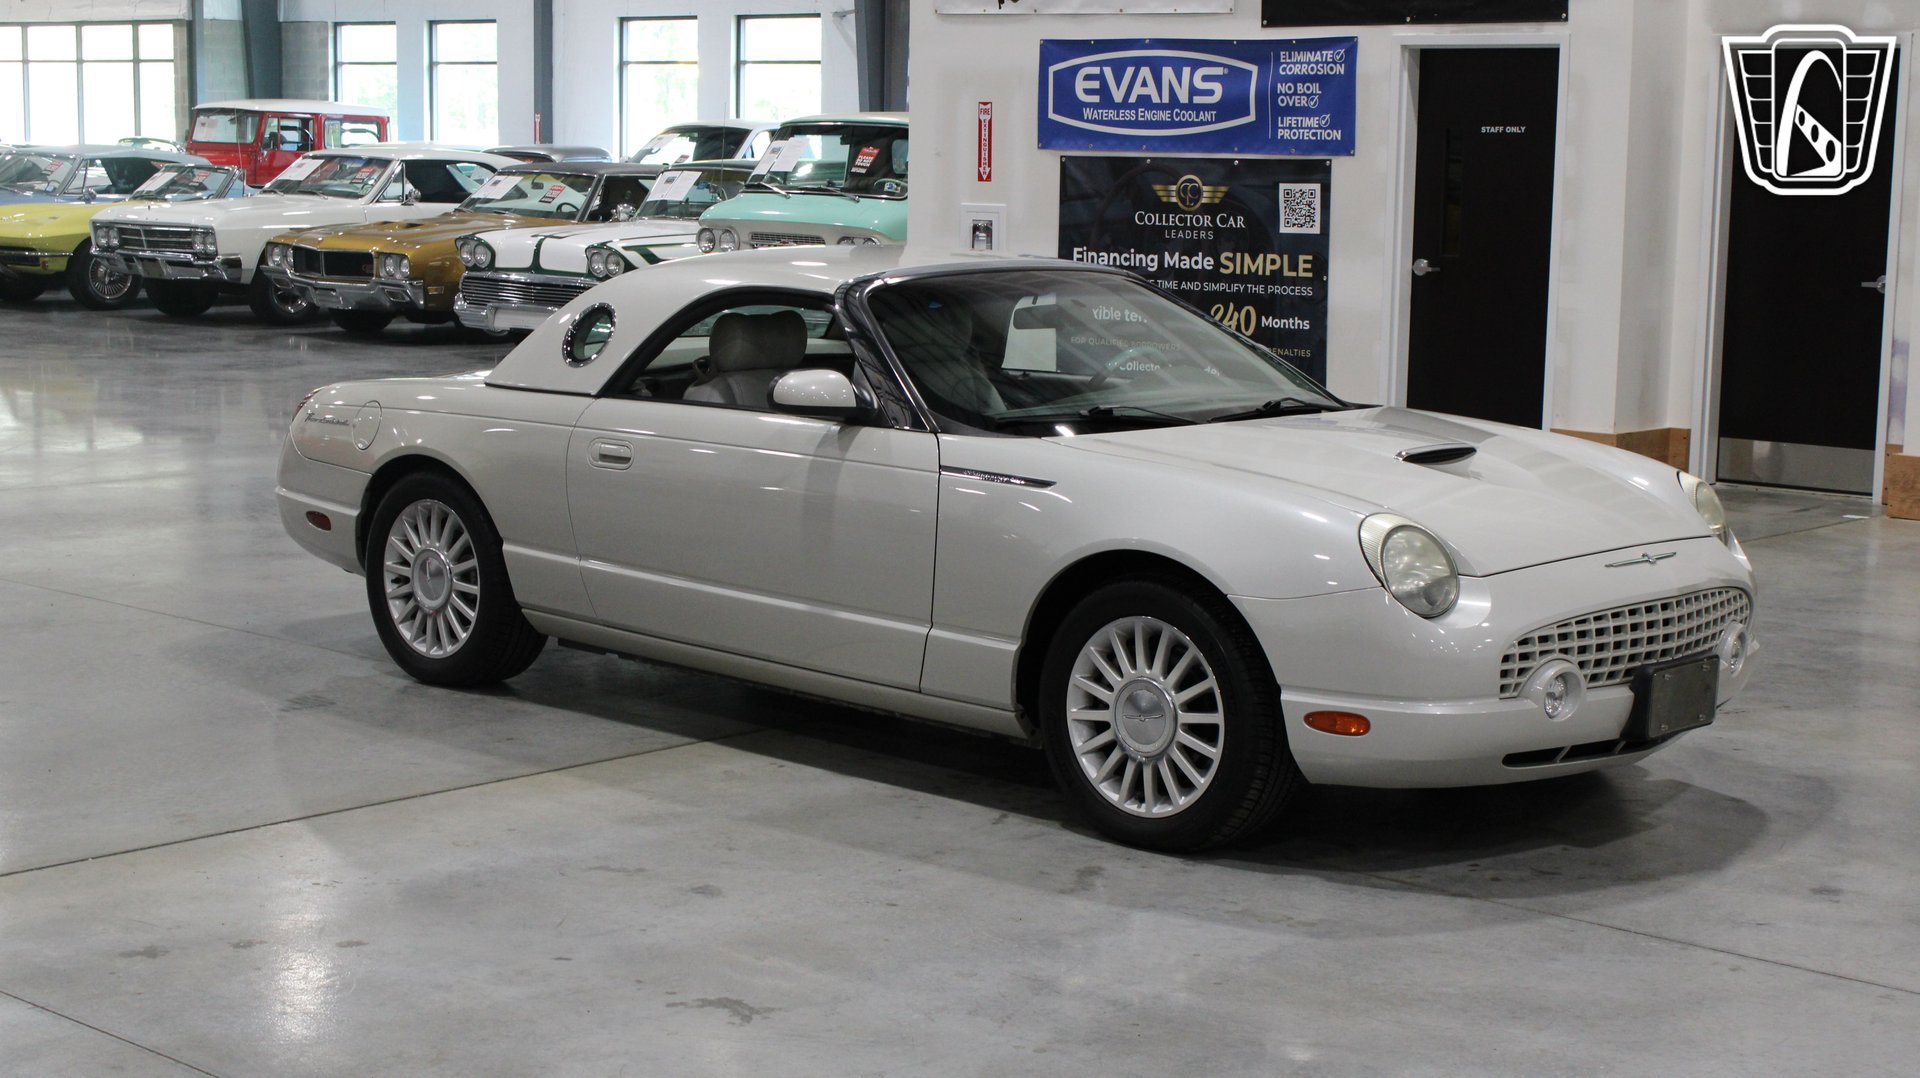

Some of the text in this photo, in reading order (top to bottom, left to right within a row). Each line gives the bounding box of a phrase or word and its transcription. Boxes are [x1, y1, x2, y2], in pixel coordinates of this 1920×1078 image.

[1280, 50, 1334, 62] ELIMINATE
[1279, 63, 1345, 75] CORROSION
[1075, 66, 1224, 104] EVANS
[1277, 82, 1322, 94] NO BOIL
[1277, 95, 1308, 107] OVER
[980, 108, 990, 116] FIRE
[1083, 107, 1217, 122] WATERLESS ENGINE COOLANT
[1277, 116, 1319, 128] LIFETIME
[1277, 129, 1342, 141] PROTECTION
[1134, 211, 1246, 228] COLLECTOR CAR
[1165, 229, 1214, 240] LEADERS
[1073, 246, 1313, 278] Financing Made SIMPLE
[1156, 279, 1179, 290] TIME
[1180, 281, 1202, 291] AND
[1203, 281, 1246, 293] SIMPLIFY
[1247, 284, 1265, 294] THE
[1267, 285, 1313, 296] PROCESS
[1210, 301, 1311, 337] 240 Months
